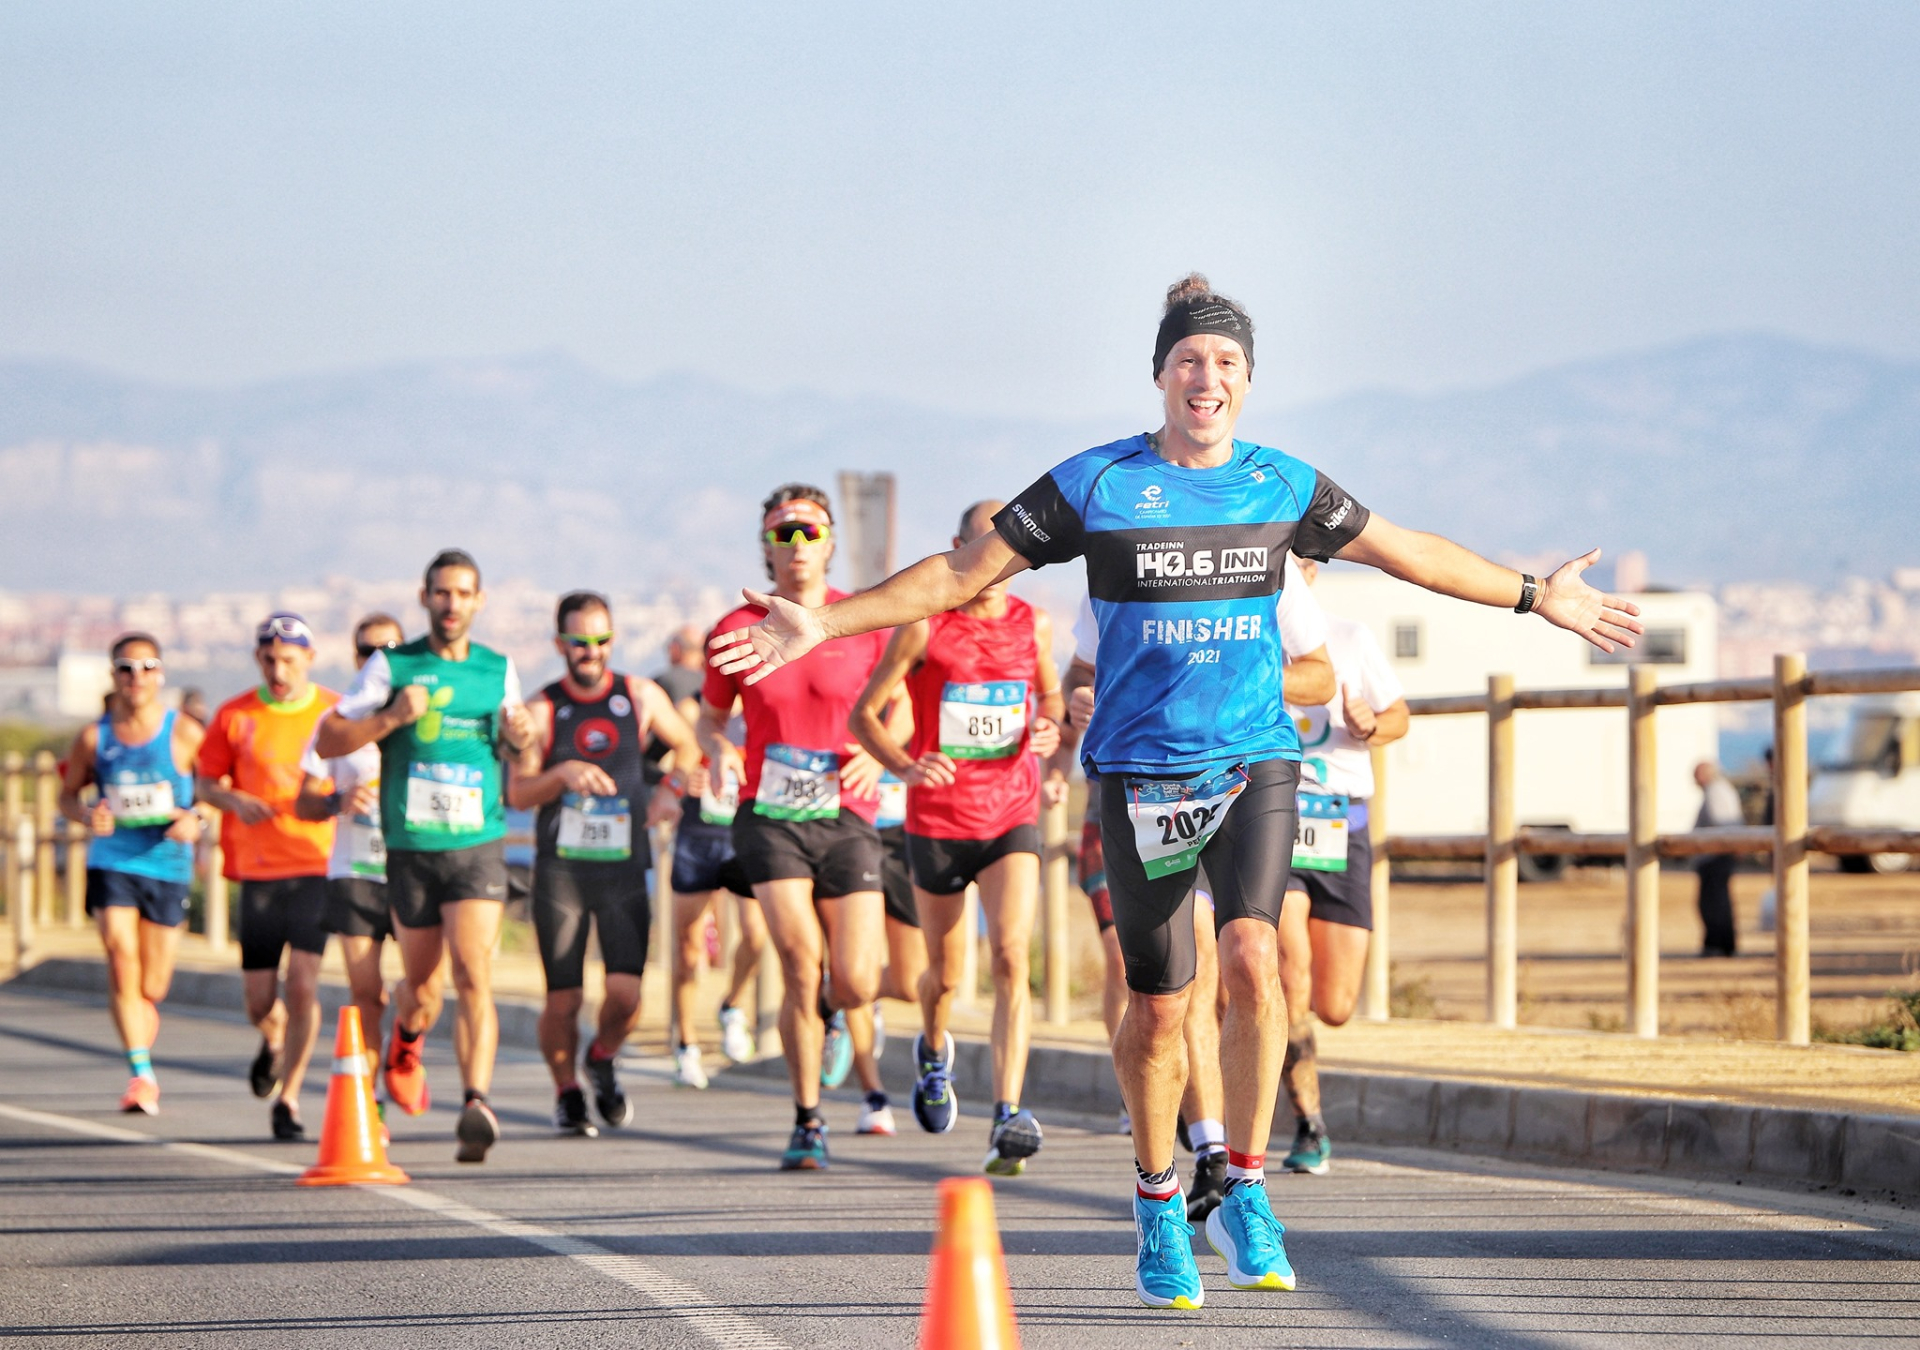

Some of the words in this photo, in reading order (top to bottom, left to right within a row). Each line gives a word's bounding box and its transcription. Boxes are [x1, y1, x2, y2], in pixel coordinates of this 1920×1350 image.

[1011, 503, 1037, 532] swim
[1323, 505, 1349, 531] bike
[1136, 541, 1184, 551] TRADEINN
[1136, 550, 1215, 579] 140.6
[1221, 548, 1266, 573] INN
[1142, 614, 1262, 645] FINISHER
[1187, 649, 1221, 666] 2021
[968, 715, 1003, 736] 851
